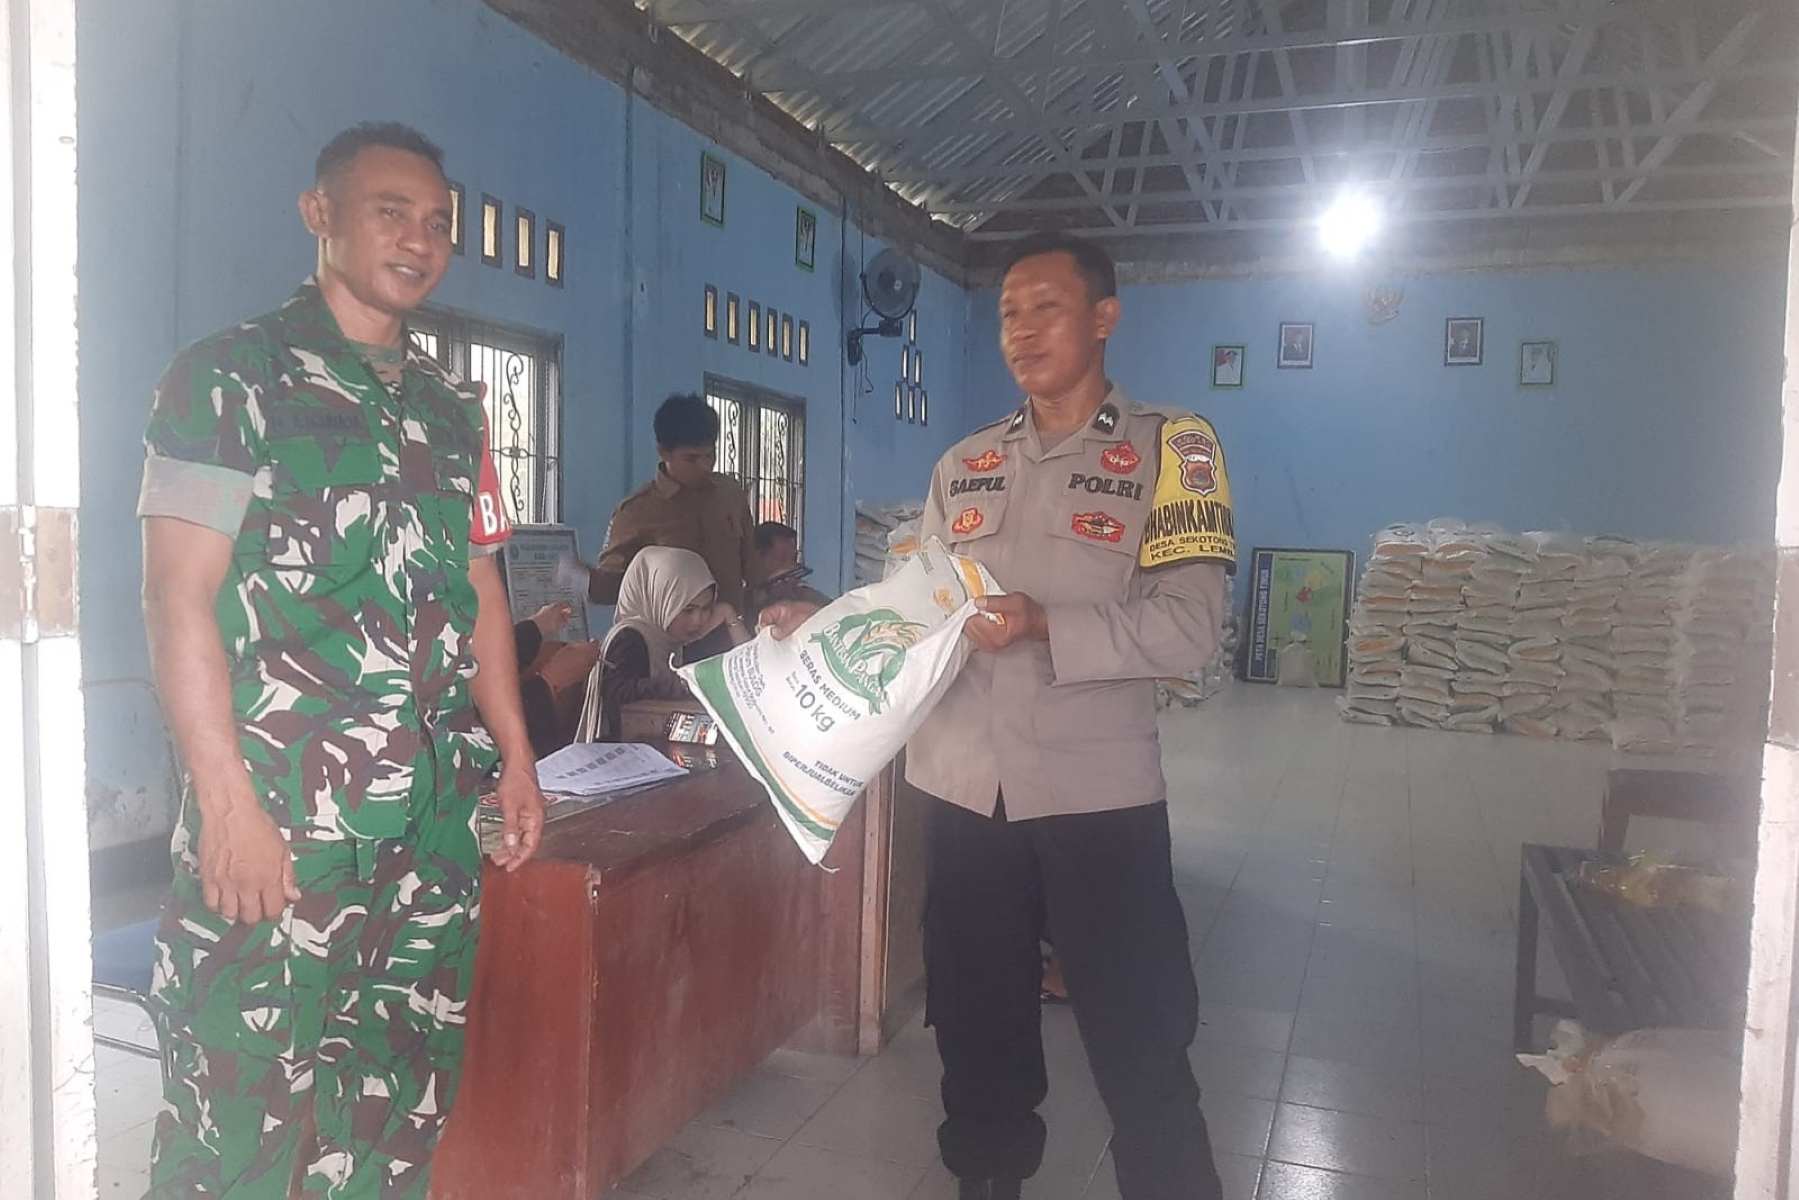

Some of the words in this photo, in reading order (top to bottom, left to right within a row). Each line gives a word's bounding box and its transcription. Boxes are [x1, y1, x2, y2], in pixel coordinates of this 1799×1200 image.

[1068, 472, 1145, 500] POLRI
[1149, 540, 1175, 552] DESA
[1151, 546, 1191, 560] KEC.
[800, 649, 822, 684] BERAS
[819, 683, 861, 720] MEDIUM
[795, 684, 816, 709] 10
[810, 704, 836, 732] kg
[814, 760, 840, 777] TIDAK
